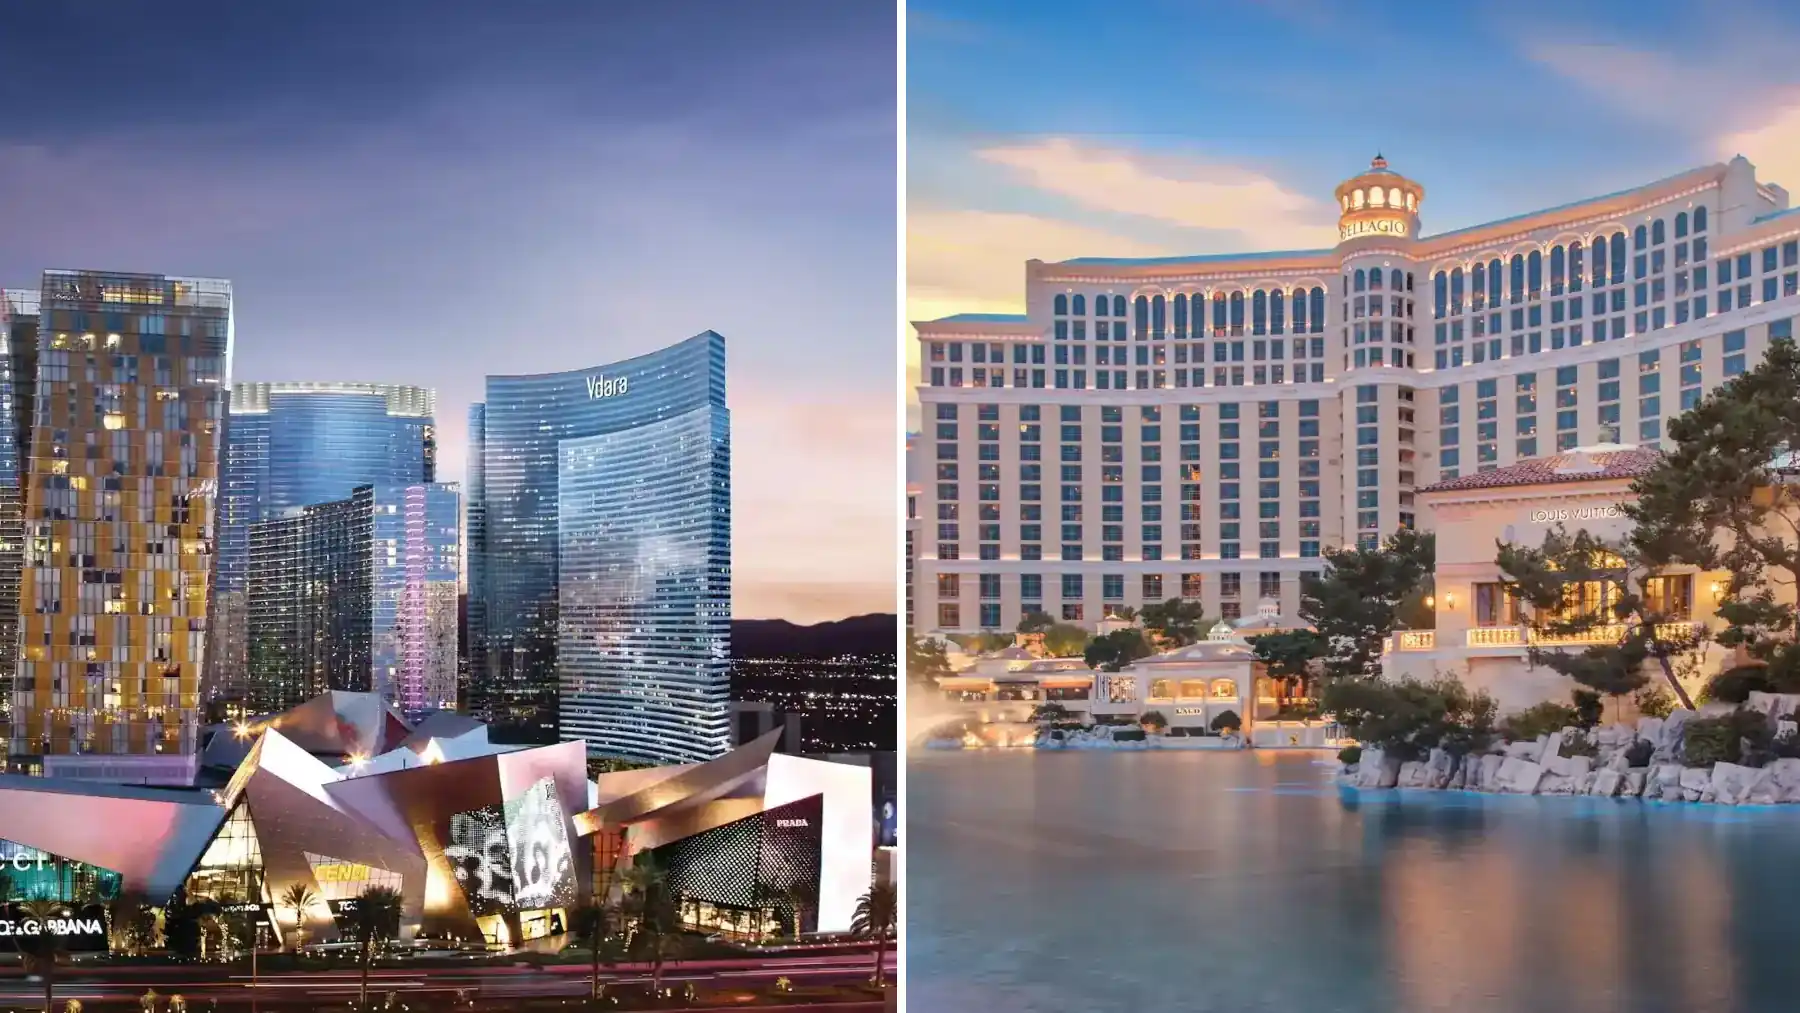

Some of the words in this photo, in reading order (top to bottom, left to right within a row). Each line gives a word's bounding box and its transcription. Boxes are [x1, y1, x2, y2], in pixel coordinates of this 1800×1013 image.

[586, 374, 628, 400] Vdara
[1530, 508, 1568, 522] LOUIS
[776, 818, 809, 828] PRADA
